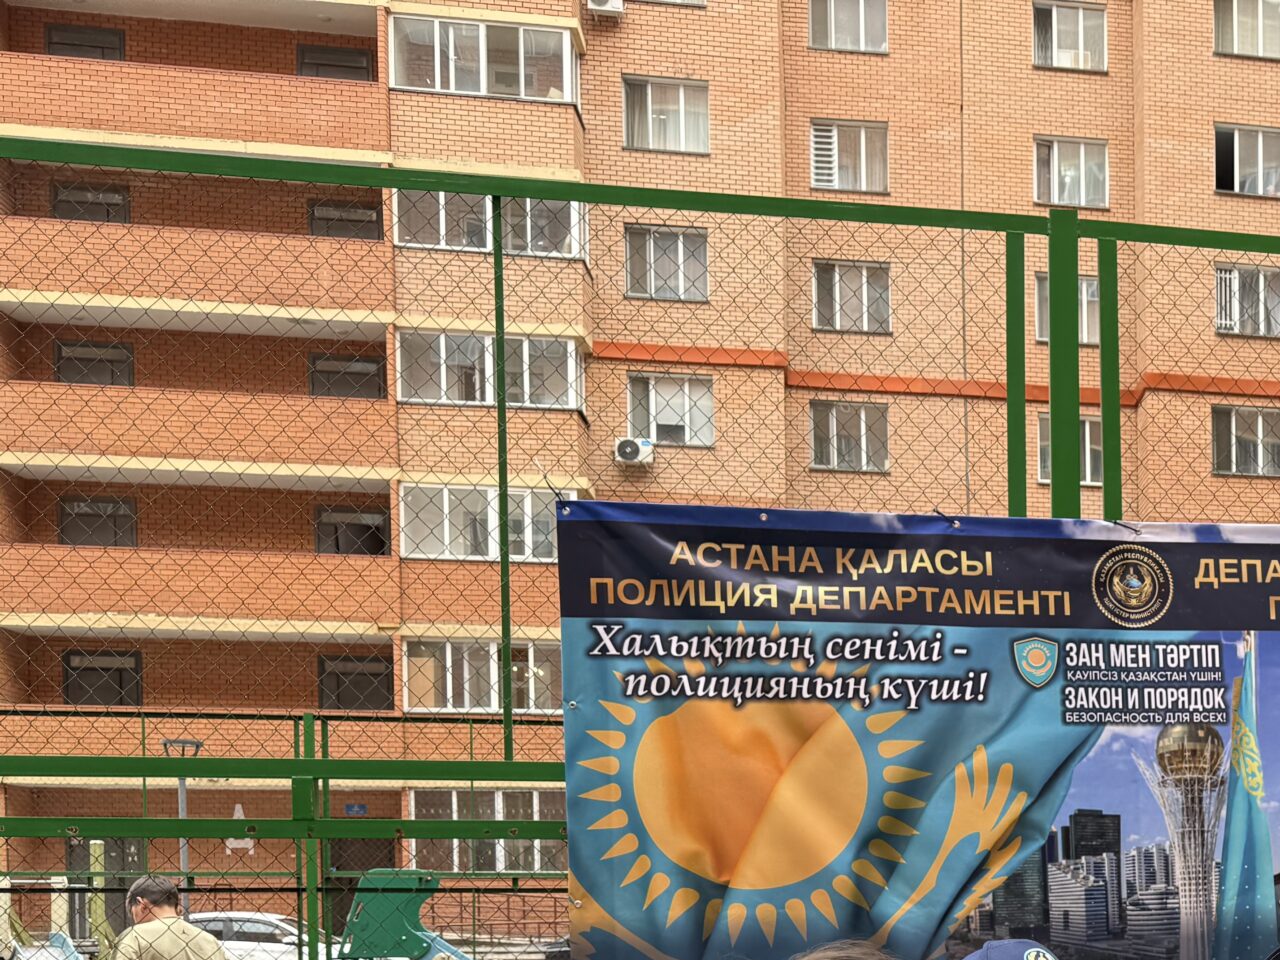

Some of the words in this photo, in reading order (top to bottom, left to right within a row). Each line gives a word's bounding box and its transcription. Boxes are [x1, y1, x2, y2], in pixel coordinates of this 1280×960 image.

[670, 541, 824, 574] АСТАНА
[836, 547, 993, 581] ҚАЛАСЫ
[589, 577, 778, 614] ПОЛИЦИЯ
[789, 584, 1071, 616] ДЕПАРТАМЕНТІ
[589, 624, 814, 666] Халықтың
[826, 630, 942, 662] сенімі
[1065, 642, 1106, 669] ЗАҢ
[1109, 643, 1151, 668] МЕН
[1154, 644, 1220, 668] ТӘРТІП
[624, 674, 870, 708] полицияның
[881, 671, 988, 709] күші!
[1067, 670, 1118, 681] ҚАУІПСІЗ
[1120, 671, 1187, 683] ҚАЗАҚСТАН
[1189, 671, 1222, 681] ҮШІН!
[1065, 686, 1123, 709] ЗАКОН
[1127, 688, 1139, 710] И
[1143, 687, 1226, 712] ПОРЯДОК
[1065, 712, 1163, 723] БЕЗОПАСНОСТЬ
[1165, 712, 1190, 724] ДЛЯ
[1193, 712, 1227, 723] ВСЕХ!
